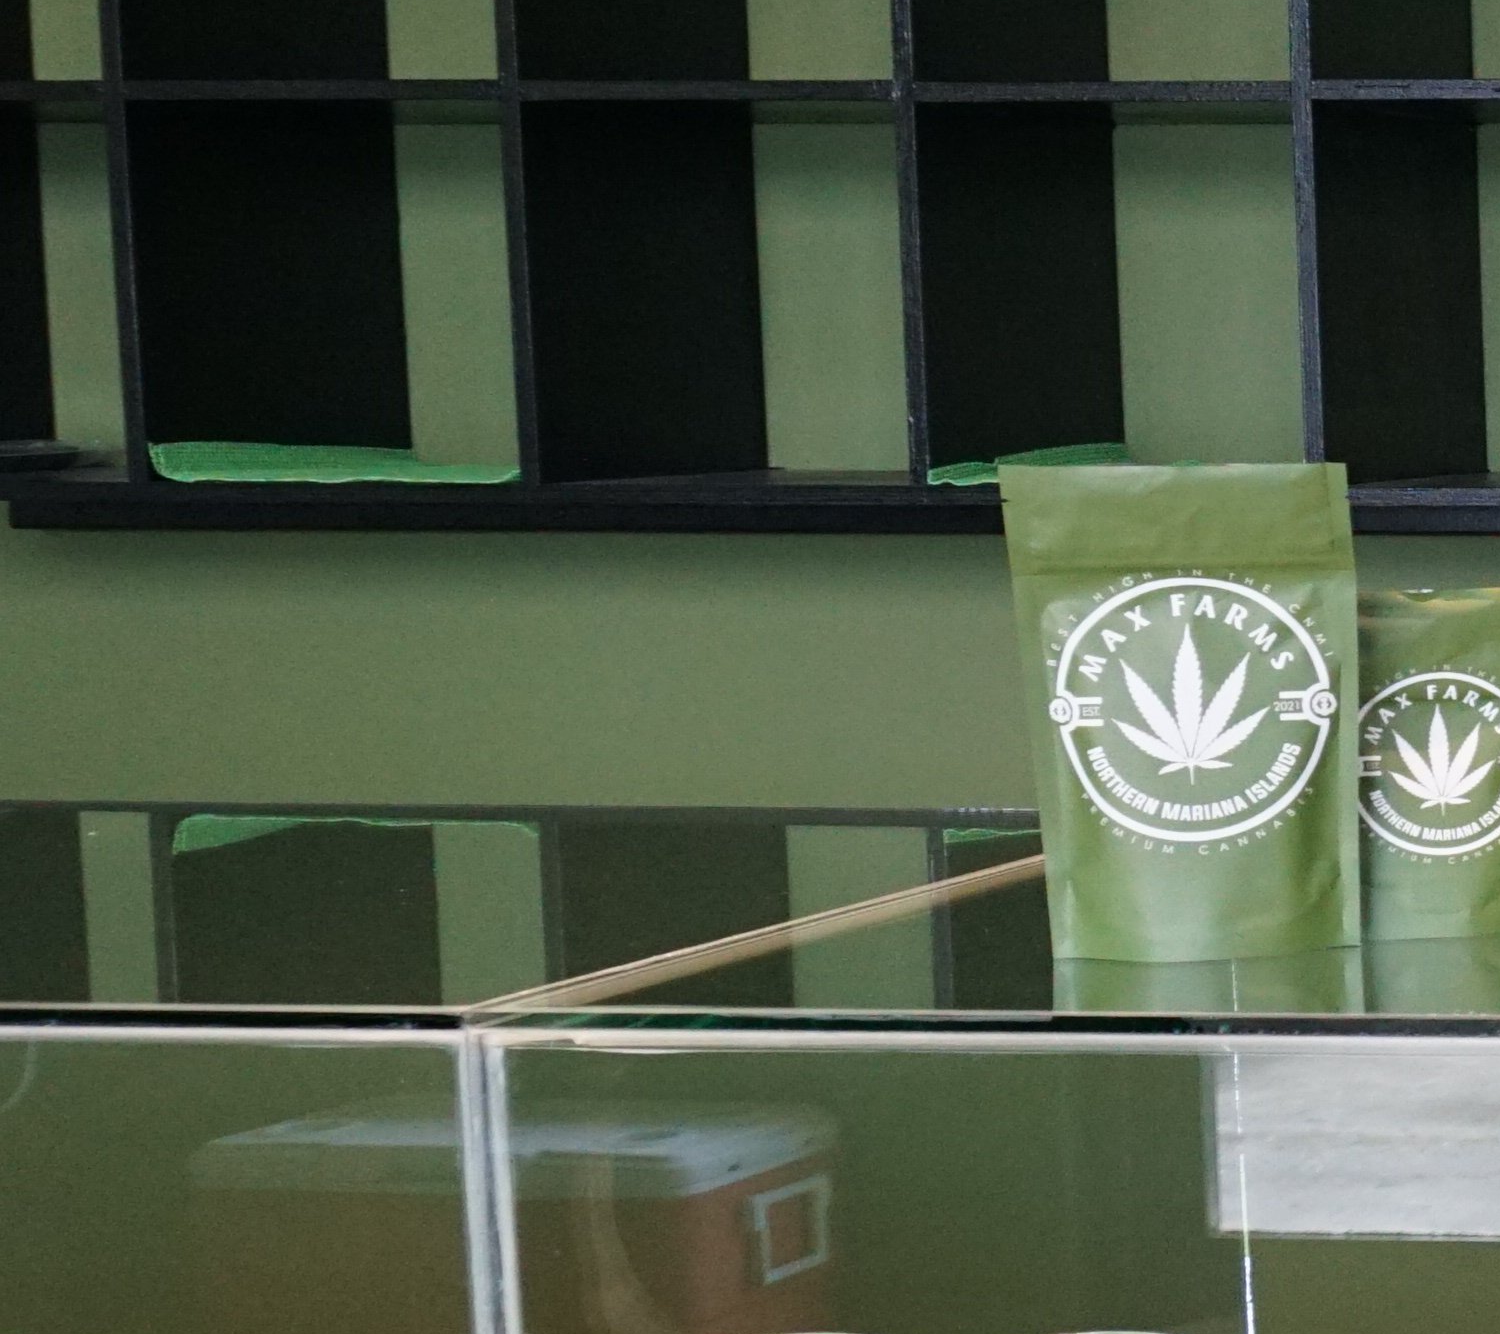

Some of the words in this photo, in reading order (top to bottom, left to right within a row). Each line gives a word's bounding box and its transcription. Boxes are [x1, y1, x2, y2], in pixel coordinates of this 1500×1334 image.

[1079, 605, 1152, 683] MAX
[1169, 593, 1294, 670] FARMS
[1092, 571, 1153, 603] HIGH
[1177, 568, 1202, 577] IN
[1228, 571, 1272, 595] THE
[1287, 602, 1335, 658] CNMI
[1272, 700, 1301, 713] 2021
[1364, 692, 1413, 746] MAX
[1086, 745, 1160, 816] NORTHERN
[1160, 795, 1248, 822] MARIANA
[1244, 742, 1302, 804] ISLANDS
[1368, 789, 1423, 838] NORTHERN
[1421, 821, 1482, 841] MARIANA
[1081, 791, 1175, 854] PREMIUM
[1198, 786, 1313, 855] CANNABIS
